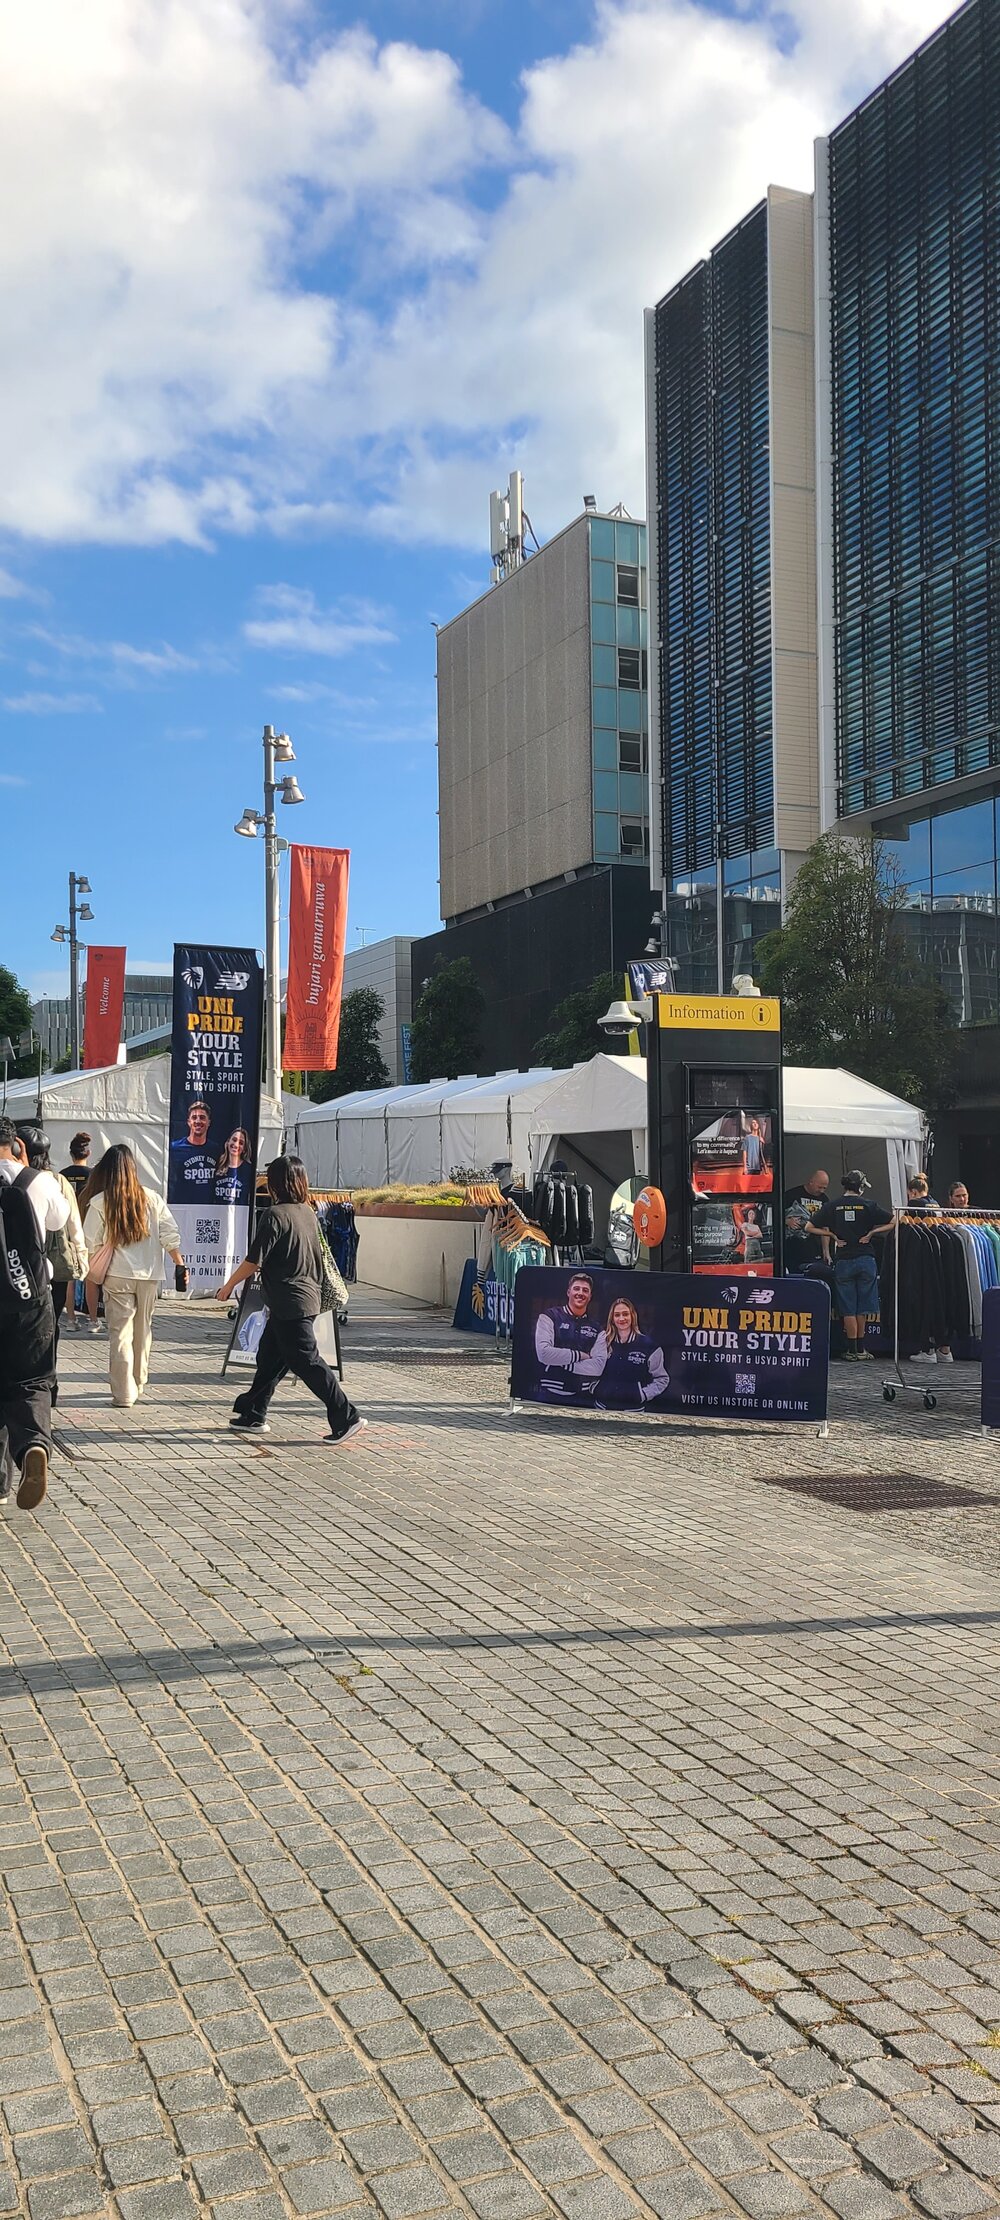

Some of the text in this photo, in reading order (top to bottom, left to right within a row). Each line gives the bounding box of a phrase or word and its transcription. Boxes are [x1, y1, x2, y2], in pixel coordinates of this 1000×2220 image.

[306, 882, 326, 1005] bujari gamarruwa
[100, 977, 110, 1015] Welcome
[198, 996, 234, 1015] UNI
[669, 1004, 745, 1020] Information
[187, 1013, 243, 1033] PRIDE
[190, 1032, 240, 1050] YOUR
[187, 1050, 243, 1068] STYLE
[186, 1070, 244, 1082] STYLE, SPORT
[185, 1082, 245, 1093] & USYD SPIRIT
[184, 1156, 205, 1168] SYDNEY
[184, 1168, 216, 1180] SPORT
[215, 1187, 242, 1198] SPORT
[196, 1255, 206, 1263] US
[210, 1255, 240, 1264] INSTORE
[8, 1249, 31, 1300] adidas
[682, 1307, 729, 1329] UNI
[739, 1310, 812, 1333] PRIDE
[682, 1329, 811, 1353] YOUR STYLE
[681, 1351, 811, 1367] STYLE, SPORT & USYD SPIRIT
[681, 1394, 808, 1410] VISIT US INSTORE OR ONLINE
